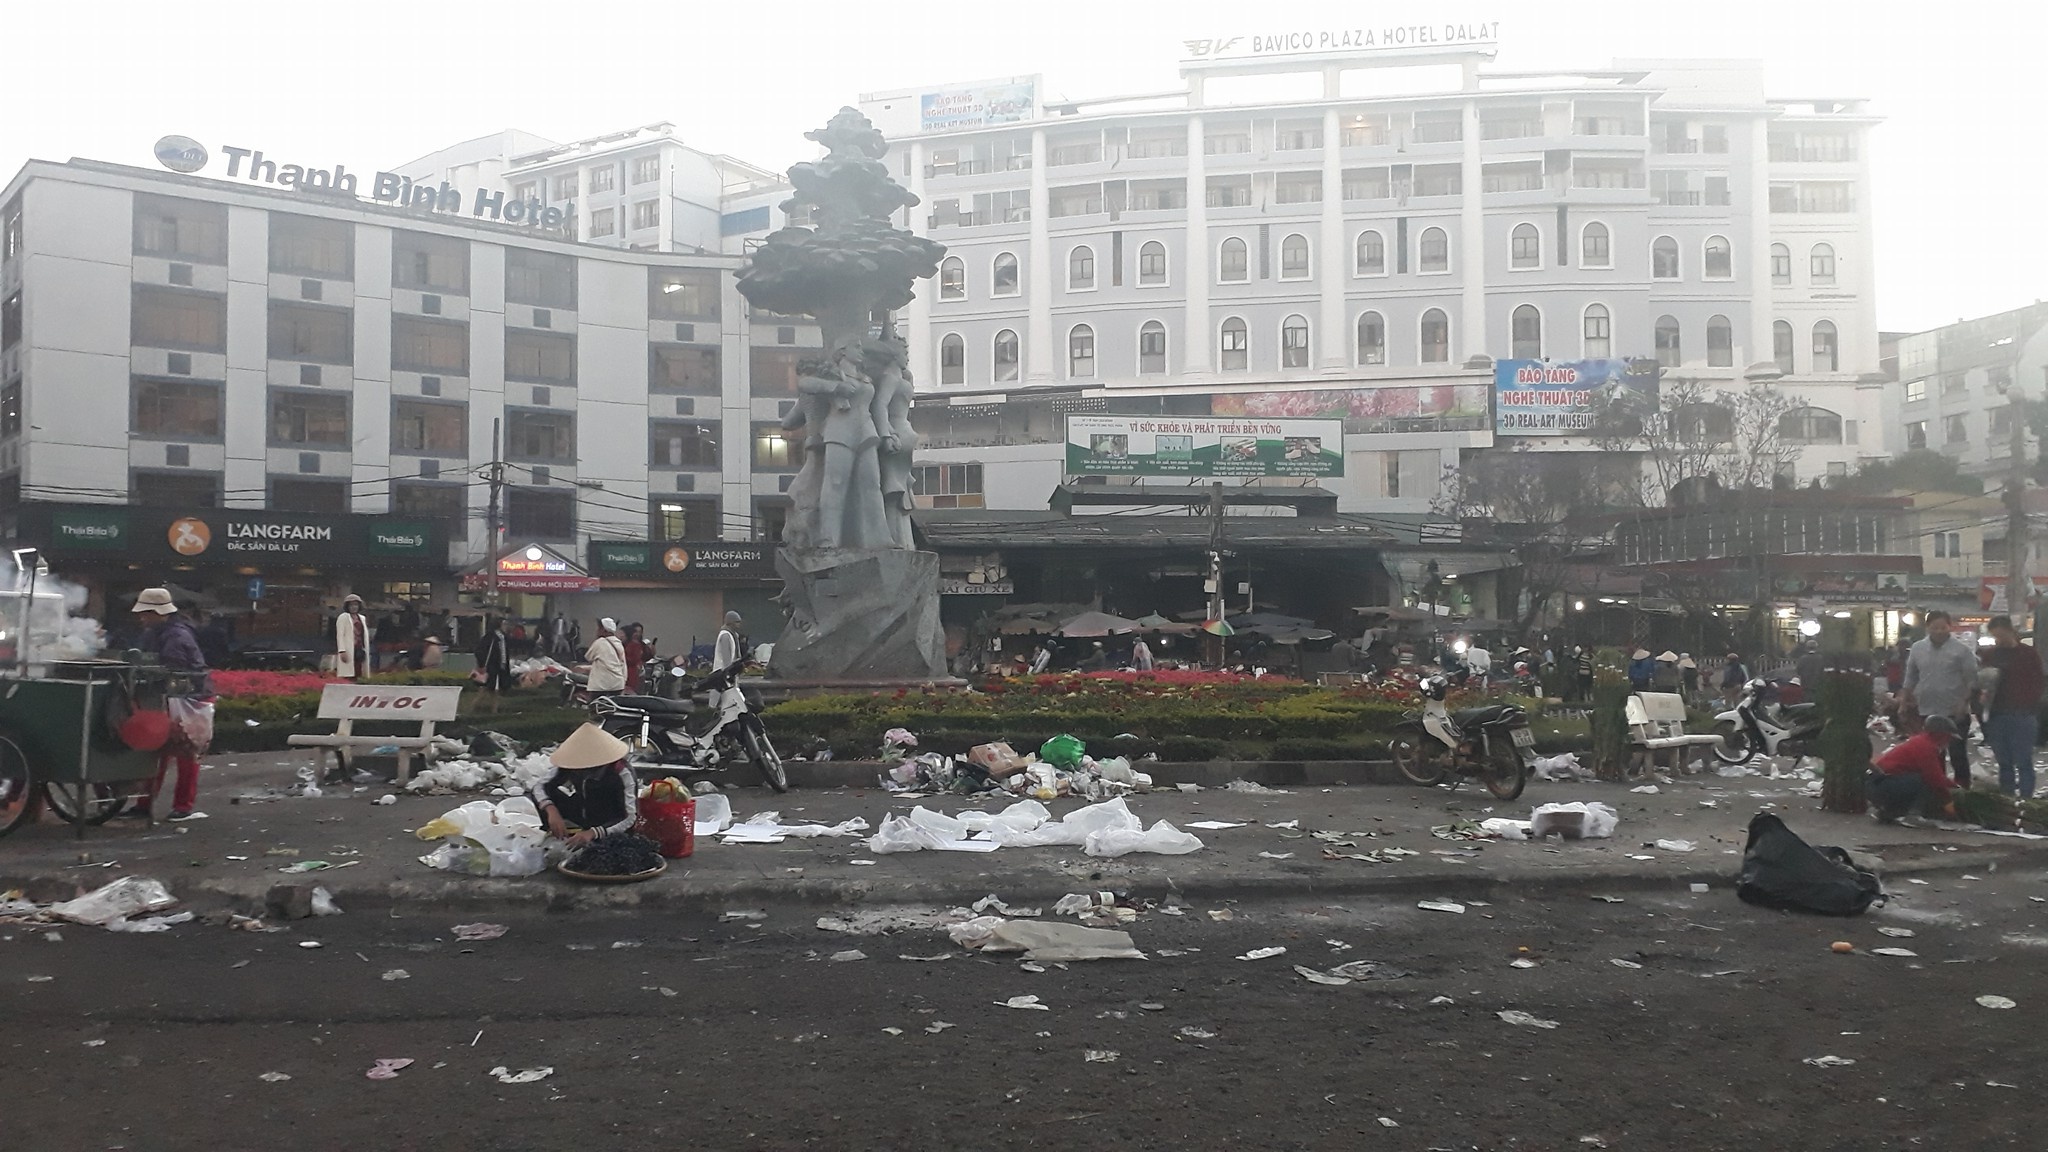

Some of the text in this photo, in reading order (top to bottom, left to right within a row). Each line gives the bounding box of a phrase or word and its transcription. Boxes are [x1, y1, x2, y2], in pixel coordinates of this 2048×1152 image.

[1253, 21, 1499, 52] BAVICO PLAZA HOTEL DALAT
[222, 145, 575, 234] Thanh Bình Hotel
[1576, 391, 1590, 405] 3D
[1503, 414, 1596, 428] 3D REAL ART MUSEUM
[502, 561, 525, 570] Thanh
[546, 562, 566, 571] Hotel
